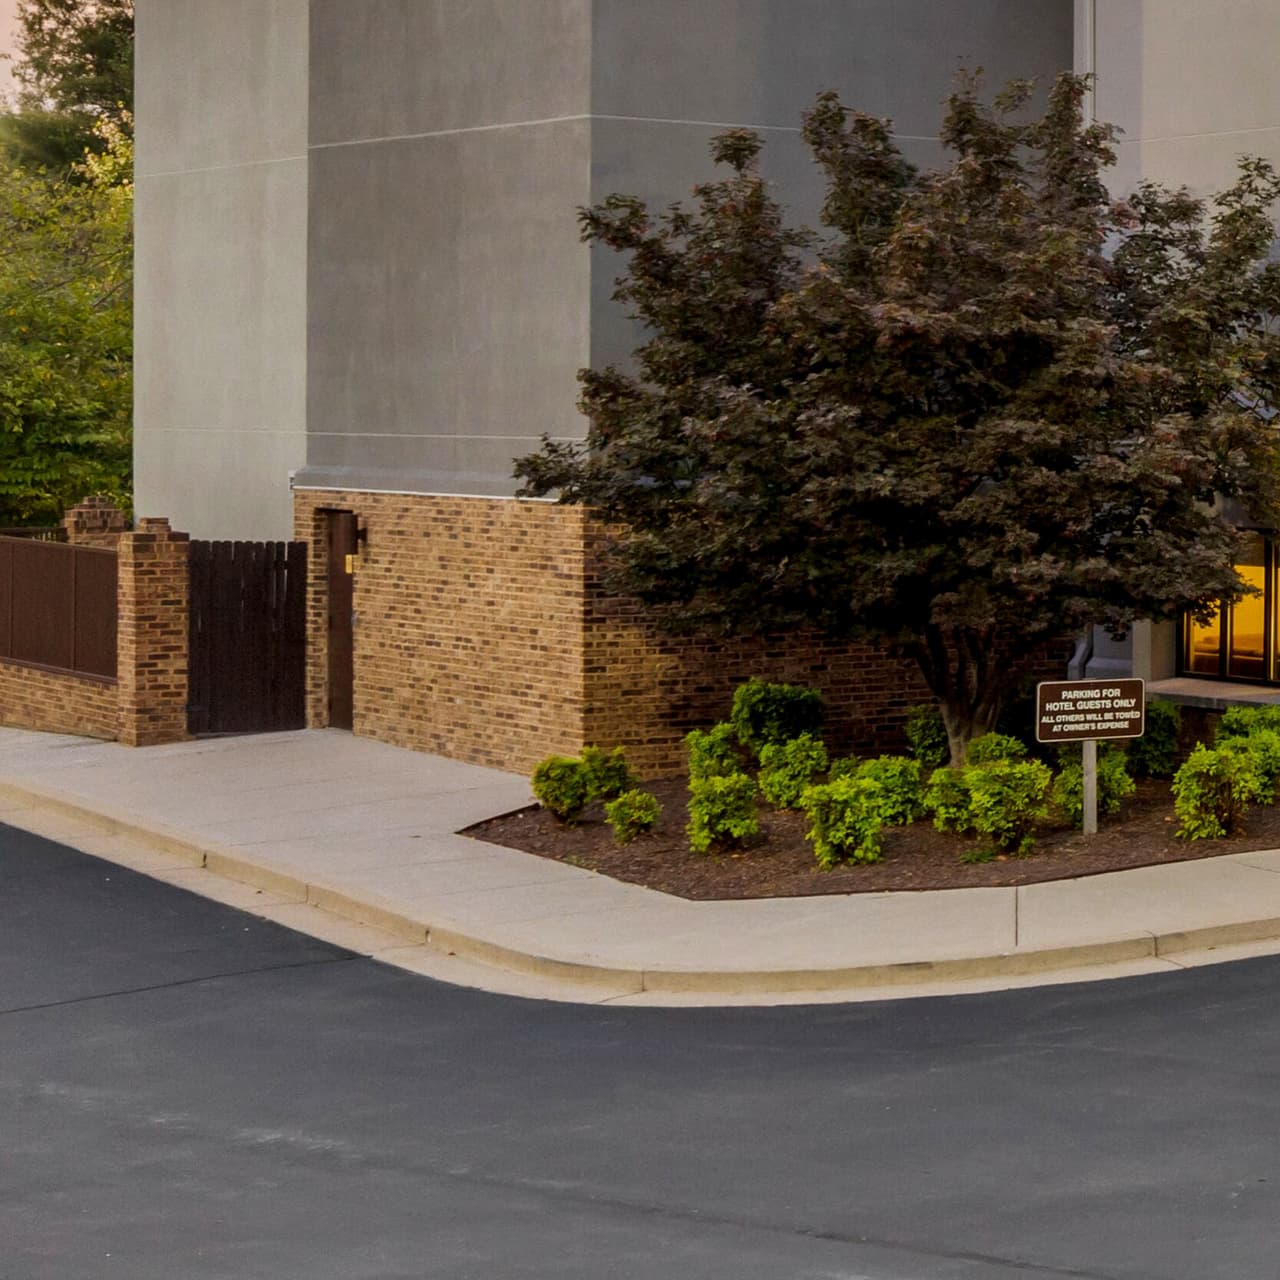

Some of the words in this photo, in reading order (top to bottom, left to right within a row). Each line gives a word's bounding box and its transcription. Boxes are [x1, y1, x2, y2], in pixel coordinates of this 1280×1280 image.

[1061, 689, 1101, 700] PARKING
[1102, 688, 1121, 697] FOR
[1045, 702, 1075, 711] HOTEL
[1076, 700, 1112, 710] GUESTS
[1113, 698, 1136, 708] ONLY
[1055, 714, 1085, 722] OTHERS
[1086, 713, 1103, 721] WILL
[1104, 712, 1114, 720] BE
[1115, 711, 1141, 719] TOWED
[1052, 724, 1062, 732] AT
[1063, 723, 1096, 732] OWNER'S
[1097, 721, 1130, 730] EXPENSE
